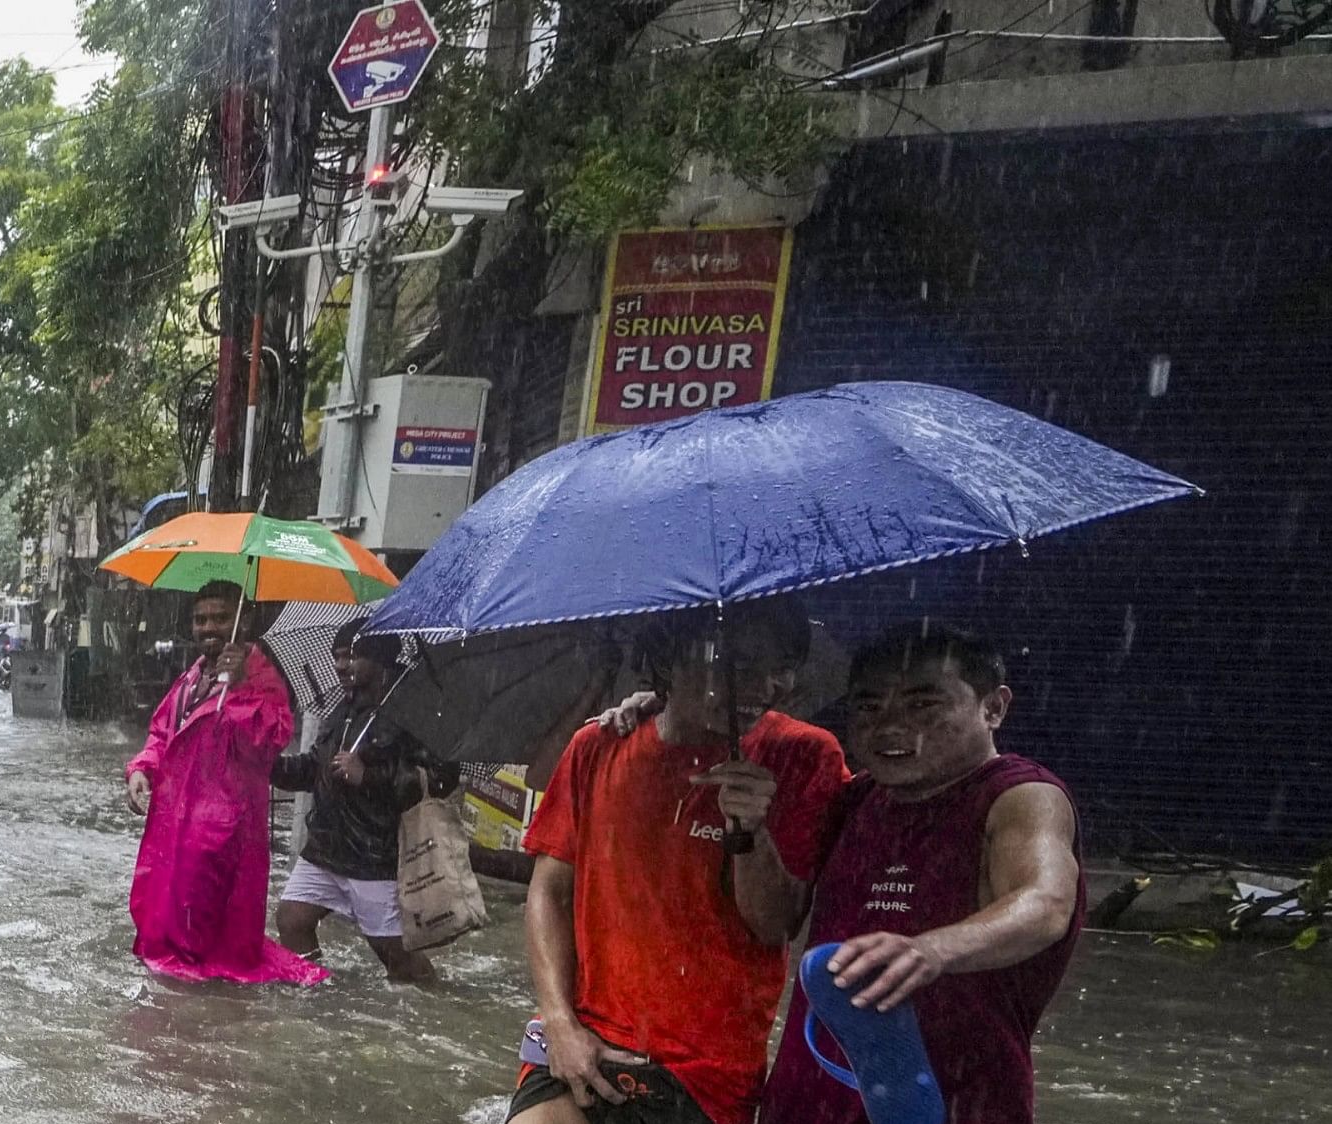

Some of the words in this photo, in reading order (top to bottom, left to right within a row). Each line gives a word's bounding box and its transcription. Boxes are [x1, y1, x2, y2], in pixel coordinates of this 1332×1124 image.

[616, 296, 642, 315] sri
[613, 313, 765, 337] SRINIVASA
[614, 343, 753, 372] FLOUR
[620, 380, 737, 409] SHOP
[405, 430, 424, 438] MEGA
[438, 431, 466, 439] PROJECT
